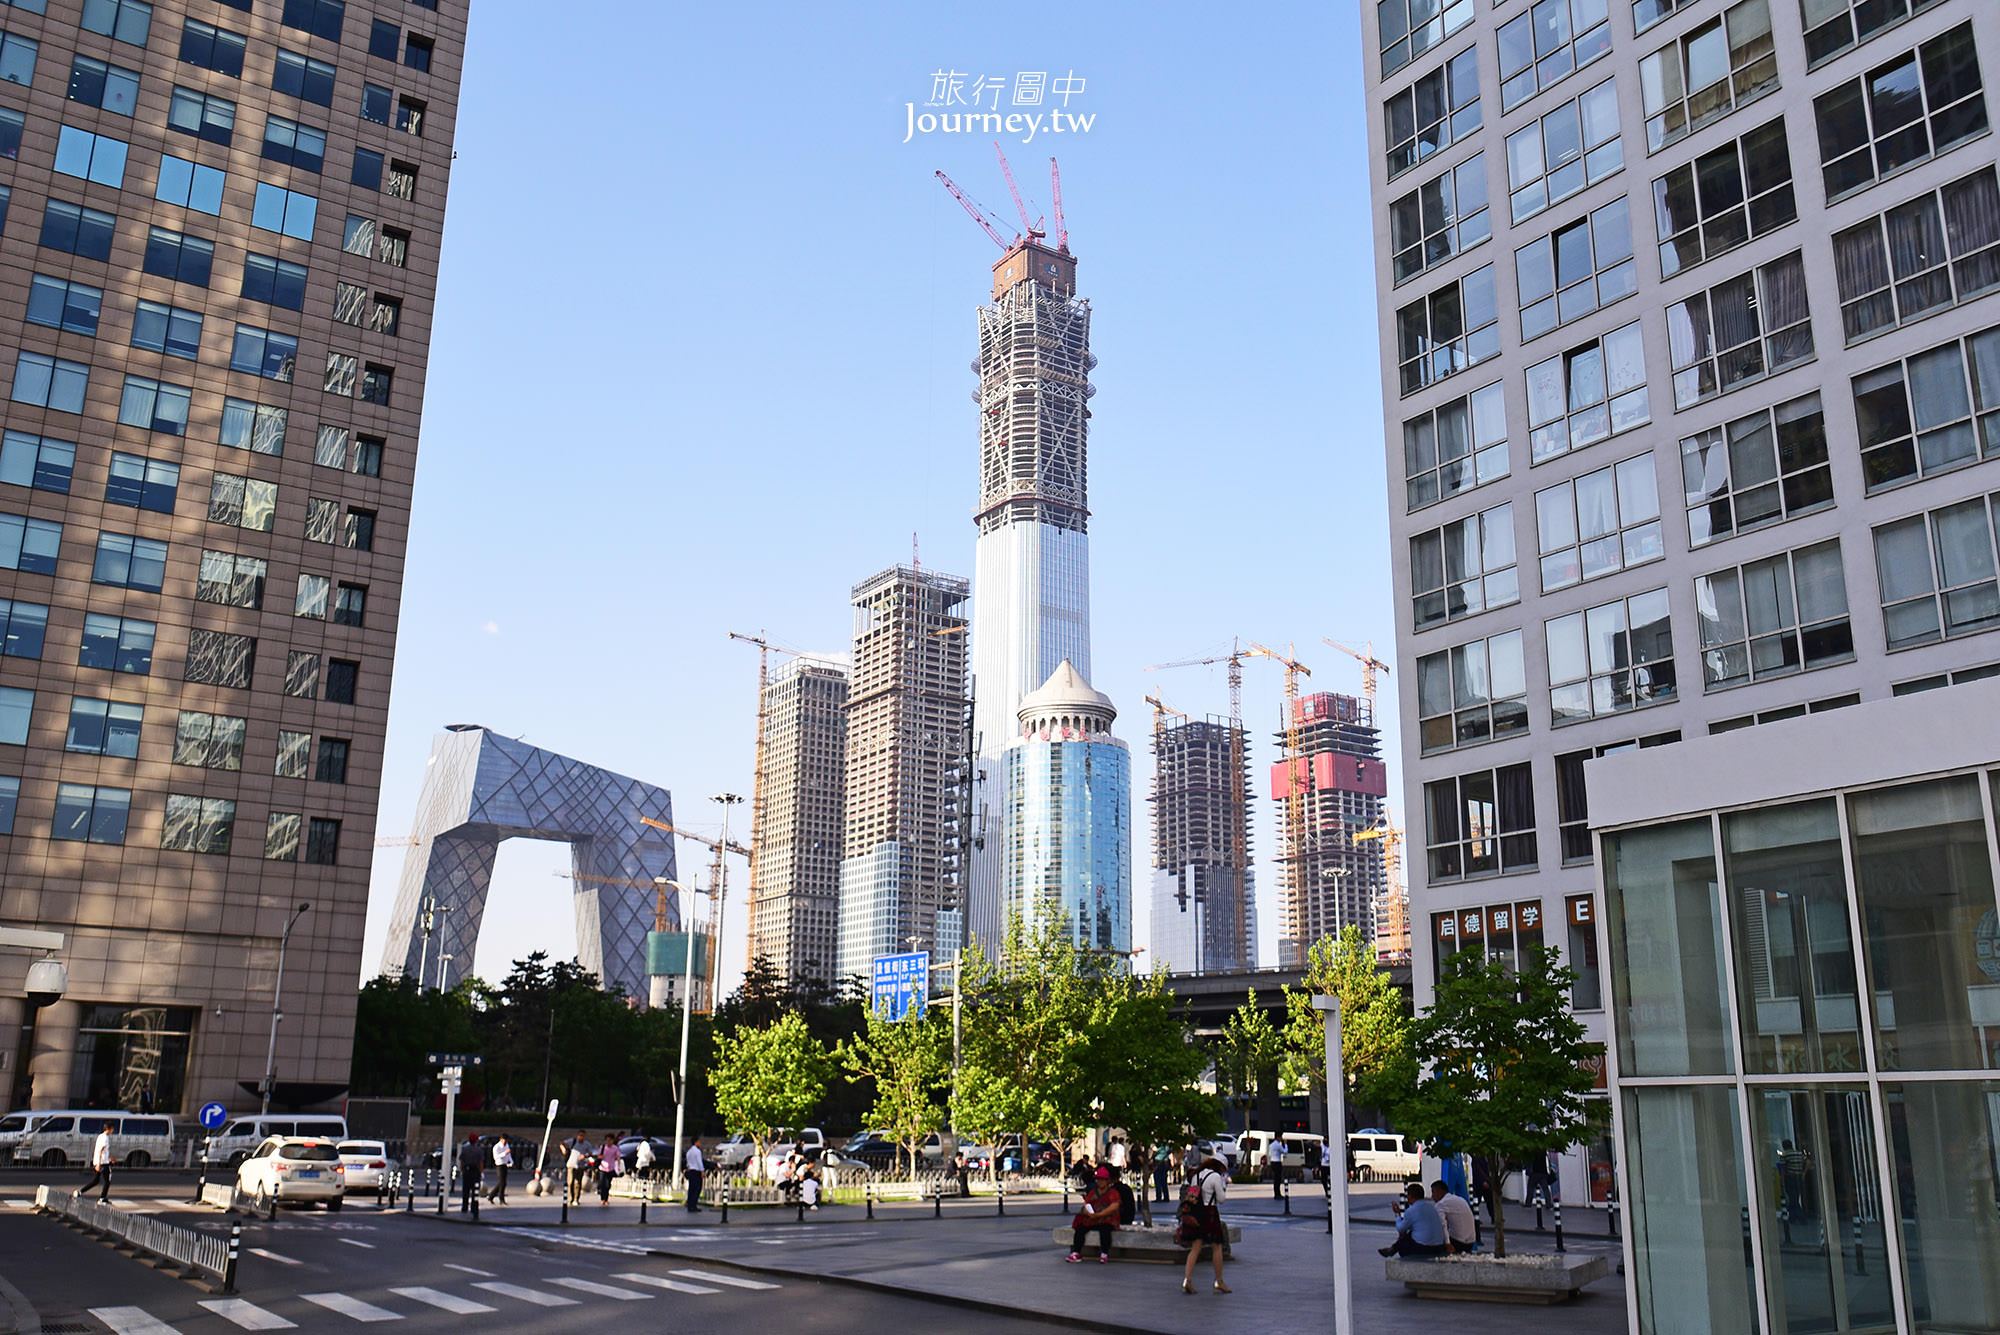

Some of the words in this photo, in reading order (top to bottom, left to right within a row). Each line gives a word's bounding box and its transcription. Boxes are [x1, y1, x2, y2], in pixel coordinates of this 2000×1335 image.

[1440, 906, 1539, 937] 启德留学
[1575, 900, 1590, 921] E
